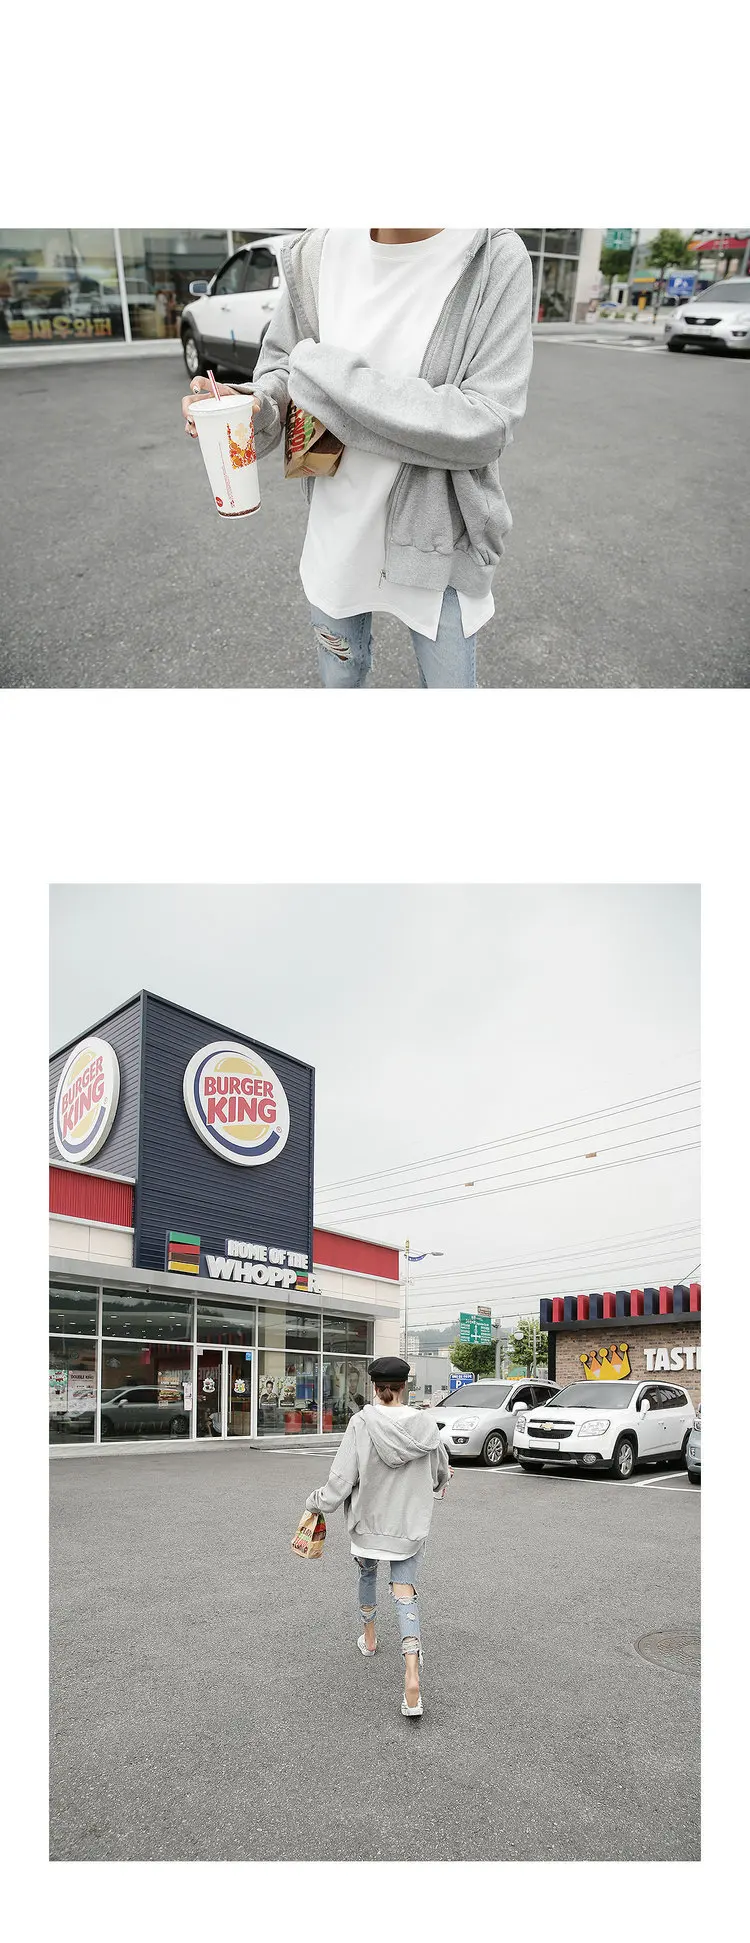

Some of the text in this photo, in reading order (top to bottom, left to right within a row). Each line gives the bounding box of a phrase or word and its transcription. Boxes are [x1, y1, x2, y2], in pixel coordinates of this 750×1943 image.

[62, 1056, 103, 1115] BURGER
[204, 1076, 274, 1098] BURGER
[62, 1073, 104, 1139] KING
[207, 1096, 277, 1124] KING
[226, 1239, 308, 1270] HOME OF THE
